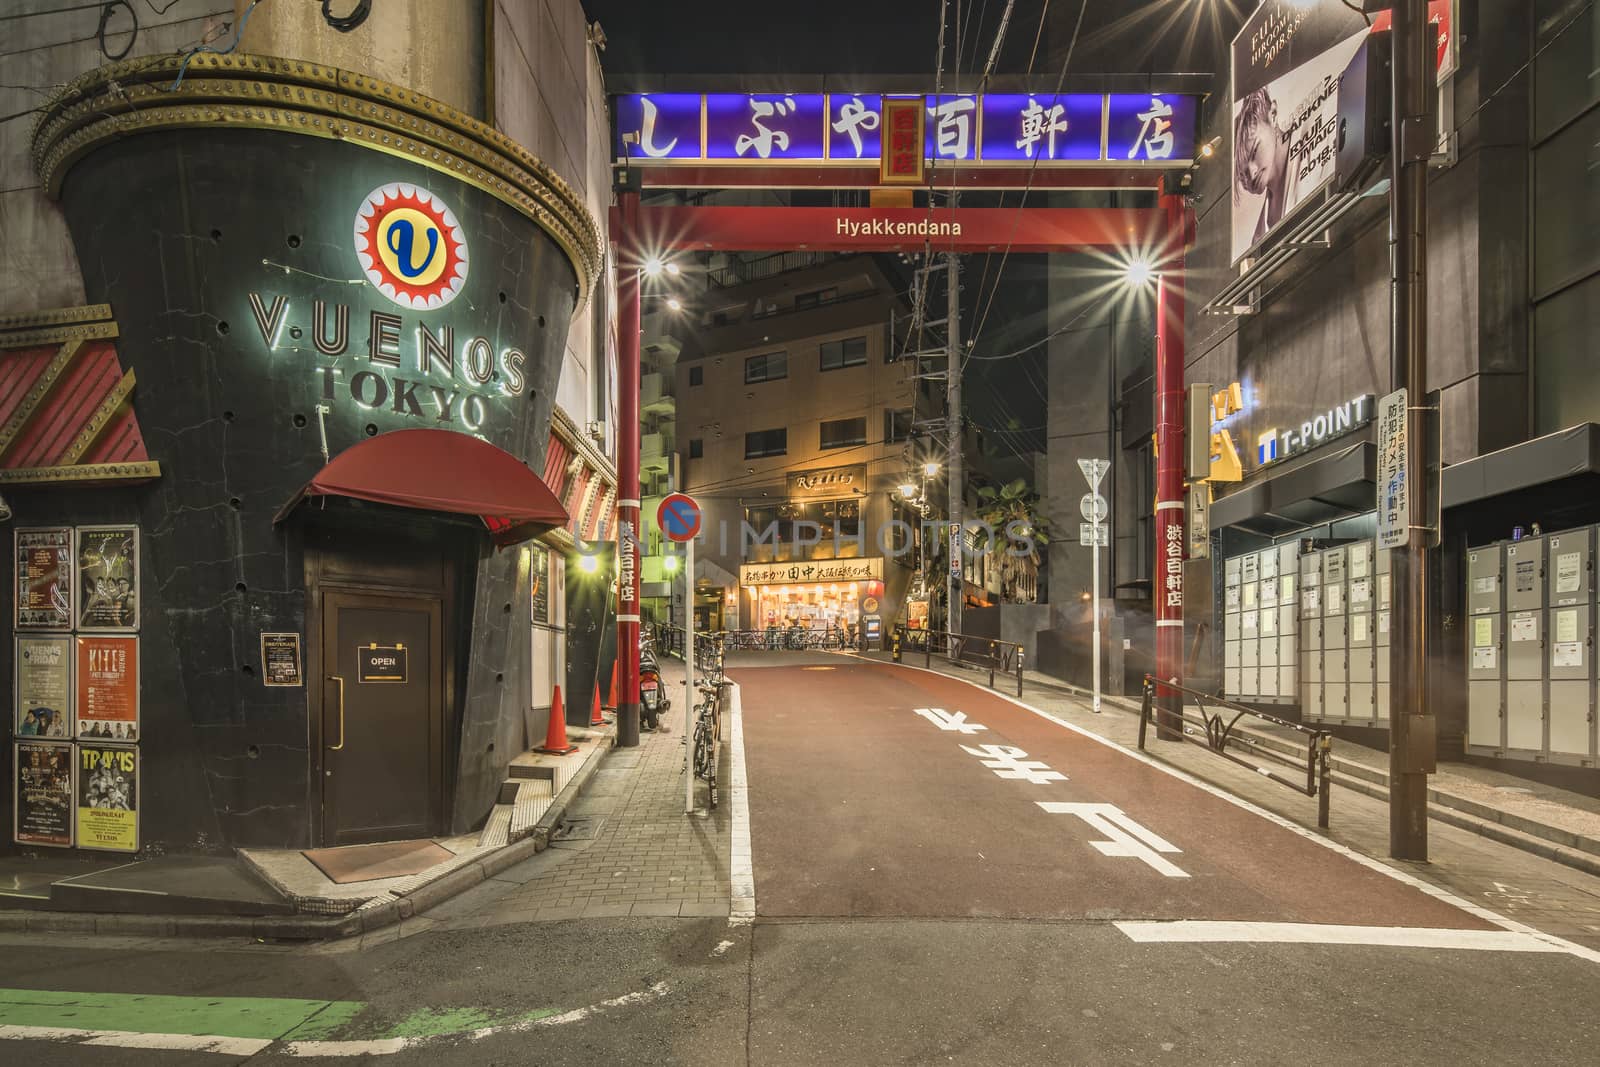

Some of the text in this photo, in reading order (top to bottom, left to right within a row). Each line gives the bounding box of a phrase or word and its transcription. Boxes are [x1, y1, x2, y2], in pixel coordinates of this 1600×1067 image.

[1289, 113, 1323, 158] RYUJI
[836, 218, 963, 237] Hyakkendana
[249, 293, 527, 398] VUENOS
[316, 366, 486, 431] TOKYO
[1282, 395, 1366, 454] T-POINT
[1388, 404, 1398, 526] 防犯カメラ作動中
[787, 565, 815, 580] 田中
[1166, 524, 1183, 607] 渋谷百軒店
[89, 649, 118, 672] KITE
[371, 657, 396, 666] OPEN
[913, 708, 1191, 878] 止まれ
